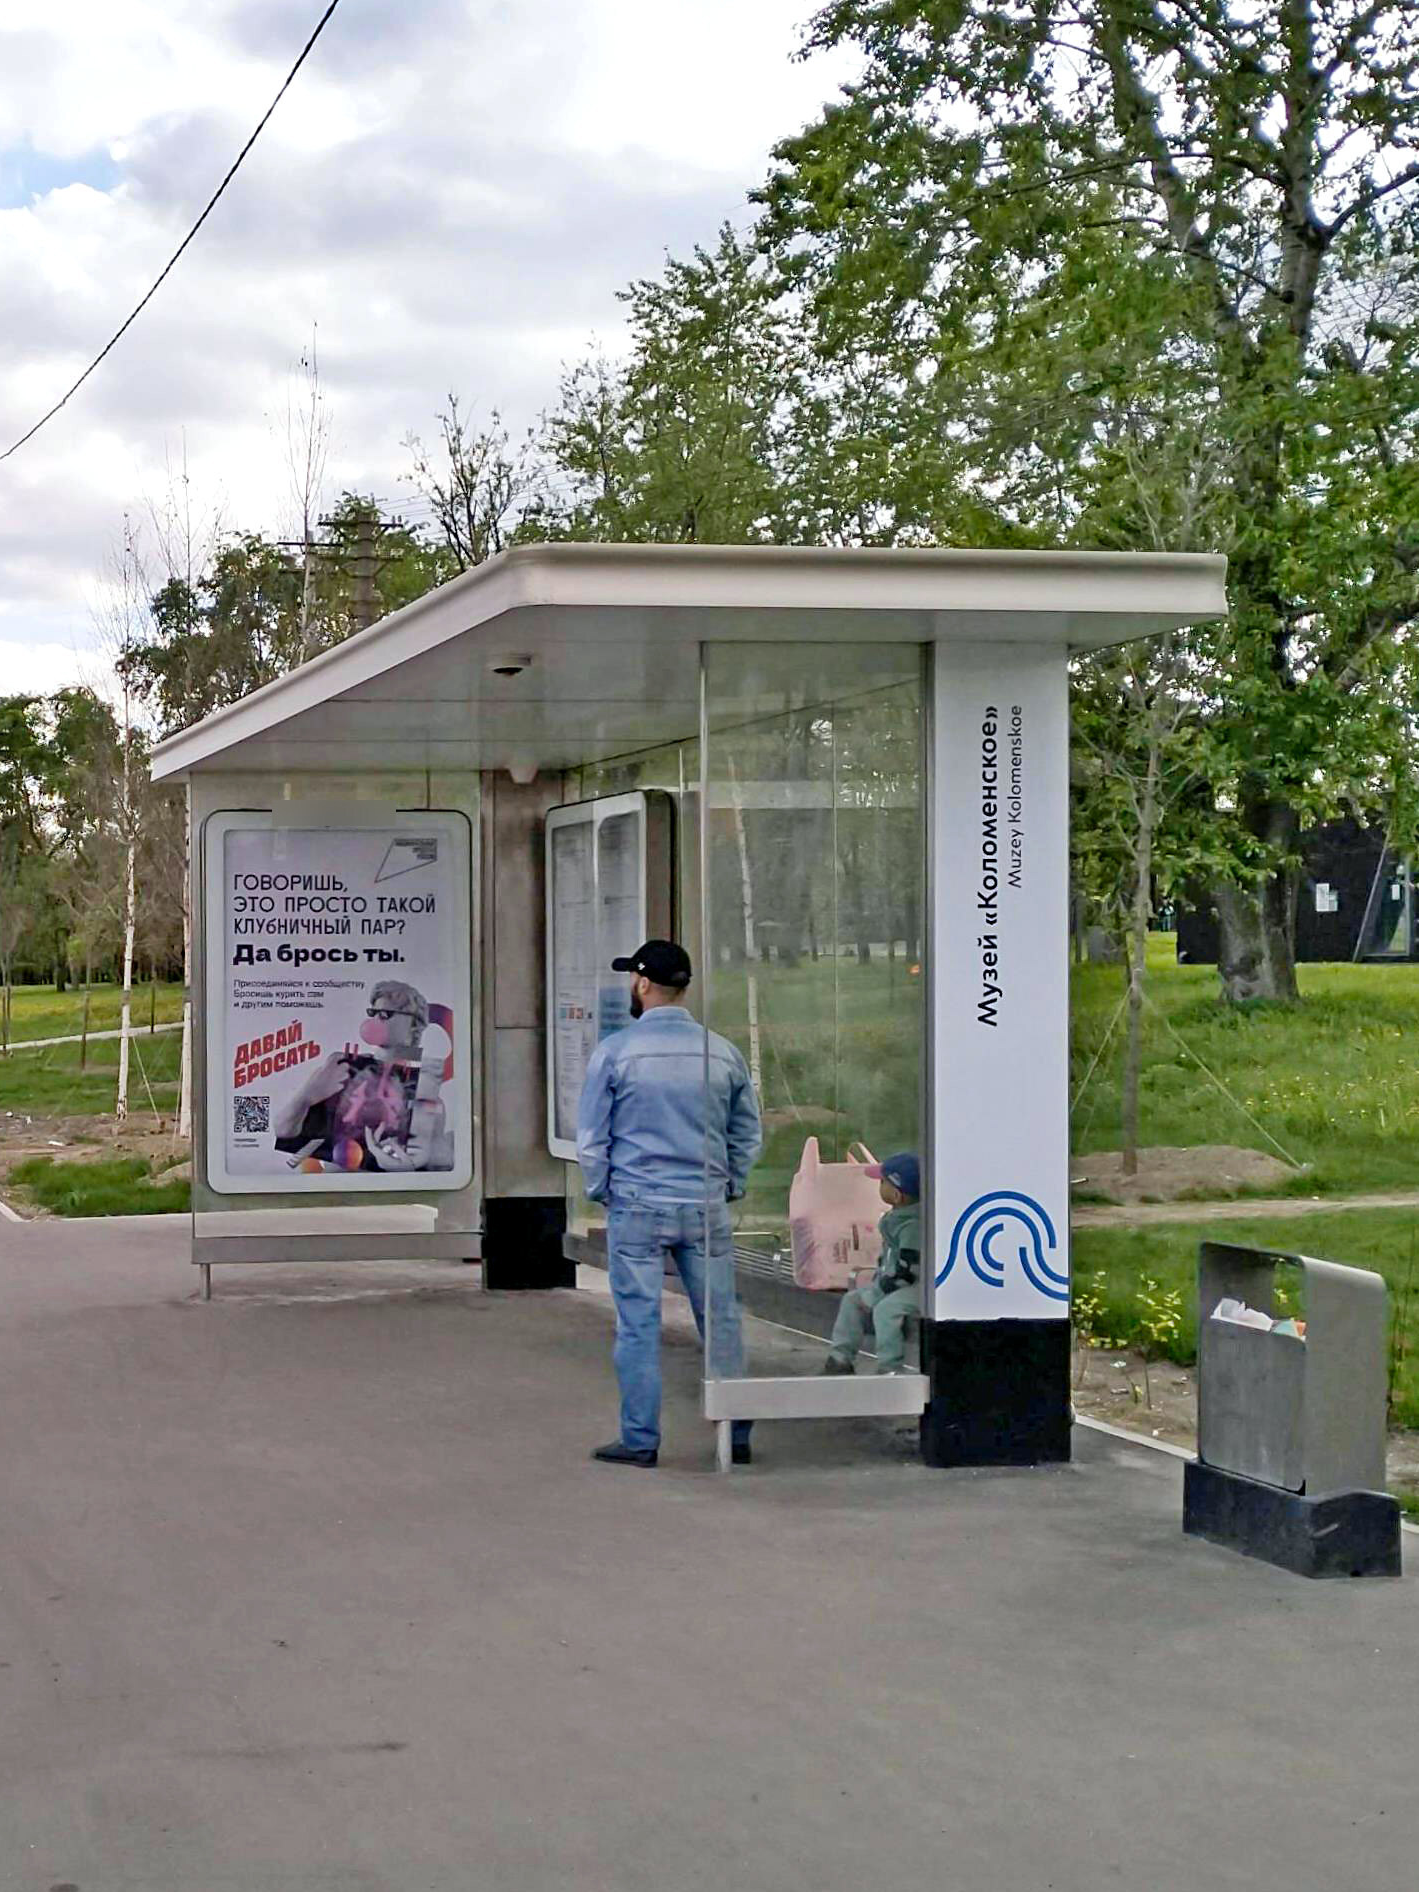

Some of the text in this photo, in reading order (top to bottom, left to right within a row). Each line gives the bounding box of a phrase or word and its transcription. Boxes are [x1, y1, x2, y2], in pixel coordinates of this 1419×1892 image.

[1007, 705, 1025, 888] Muzey Kolomenskoe
[977, 705, 1003, 1026] Музей «Коломенское»
[233, 874, 348, 892] ГОВОРИШЬ,
[233, 893, 436, 913] ЭТО ПРОСТО ТАКОЙ
[361, 918, 406, 935] ПАР?
[232, 943, 405, 967] Да брось ты.
[241, 1001, 274, 1009] другим
[275, 990, 305, 999] курить
[234, 1019, 303, 1068] ДАВАЙ
[234, 1040, 321, 1089] БРОСАТЬ
